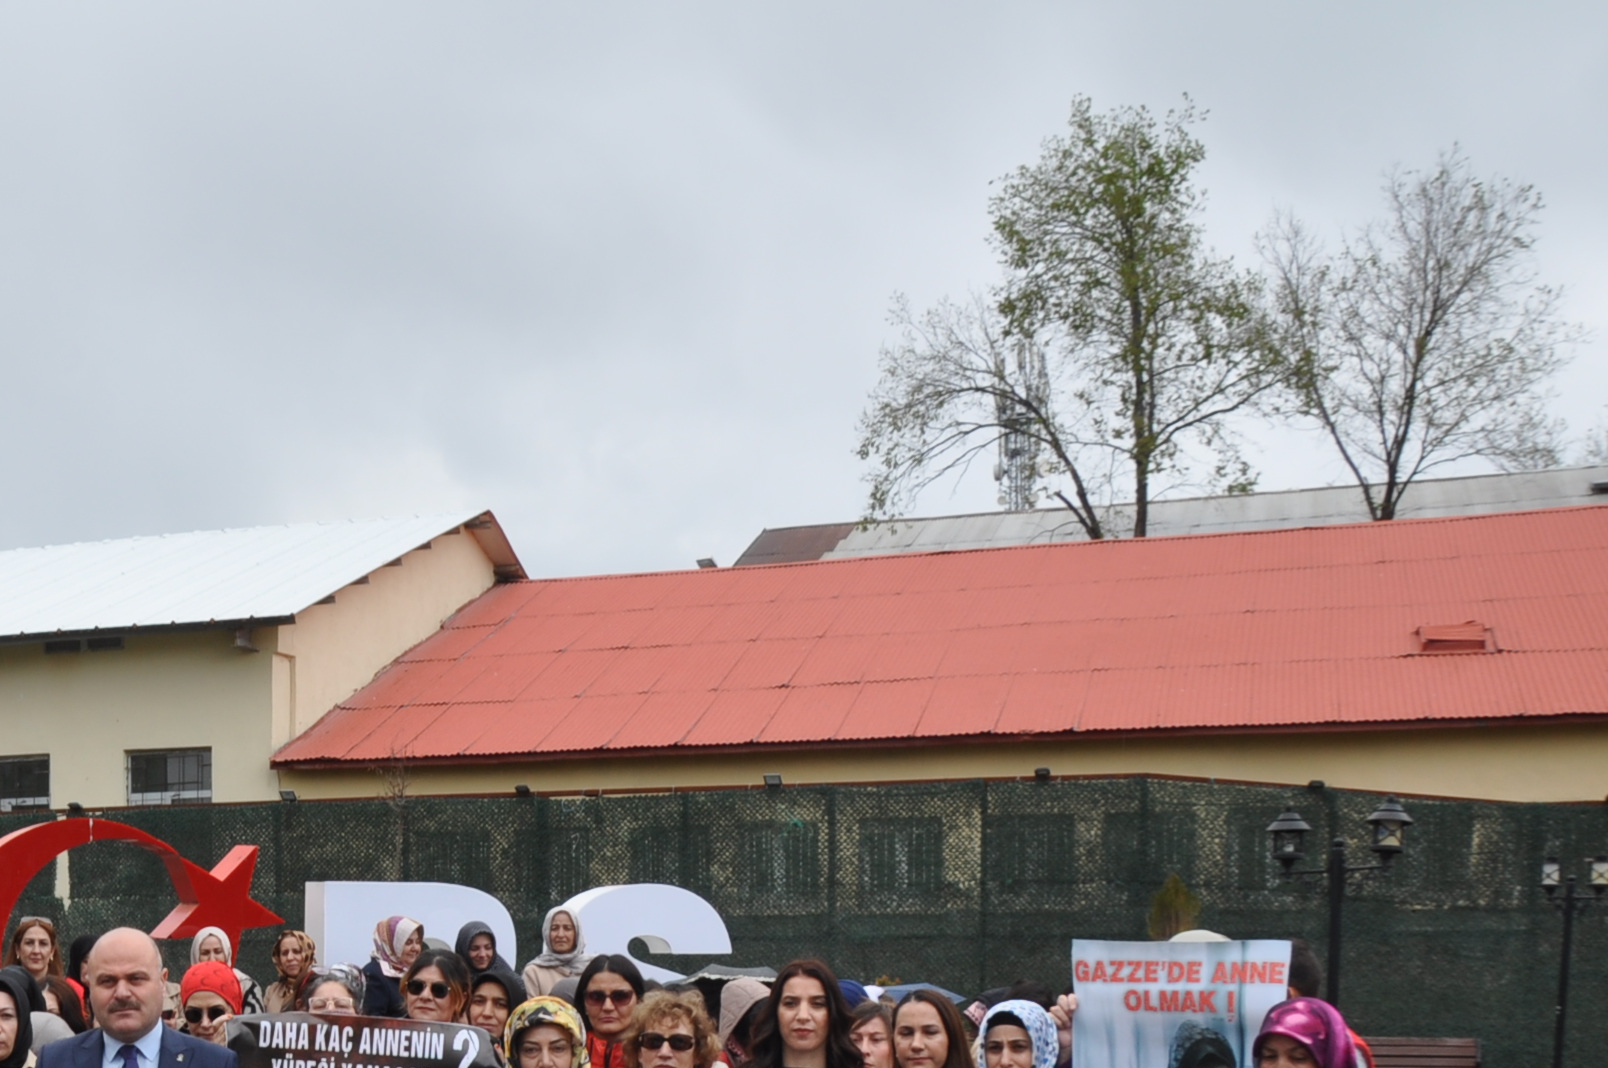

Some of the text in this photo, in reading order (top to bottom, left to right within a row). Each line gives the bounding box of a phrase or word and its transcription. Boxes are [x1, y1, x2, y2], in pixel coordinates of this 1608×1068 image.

[1074, 960, 1286, 984] GAZZE'DE ANNE
[1124, 989, 1217, 1014] OLMAK
[258, 1020, 445, 1060] DAHA KAÇ ANNENİN
